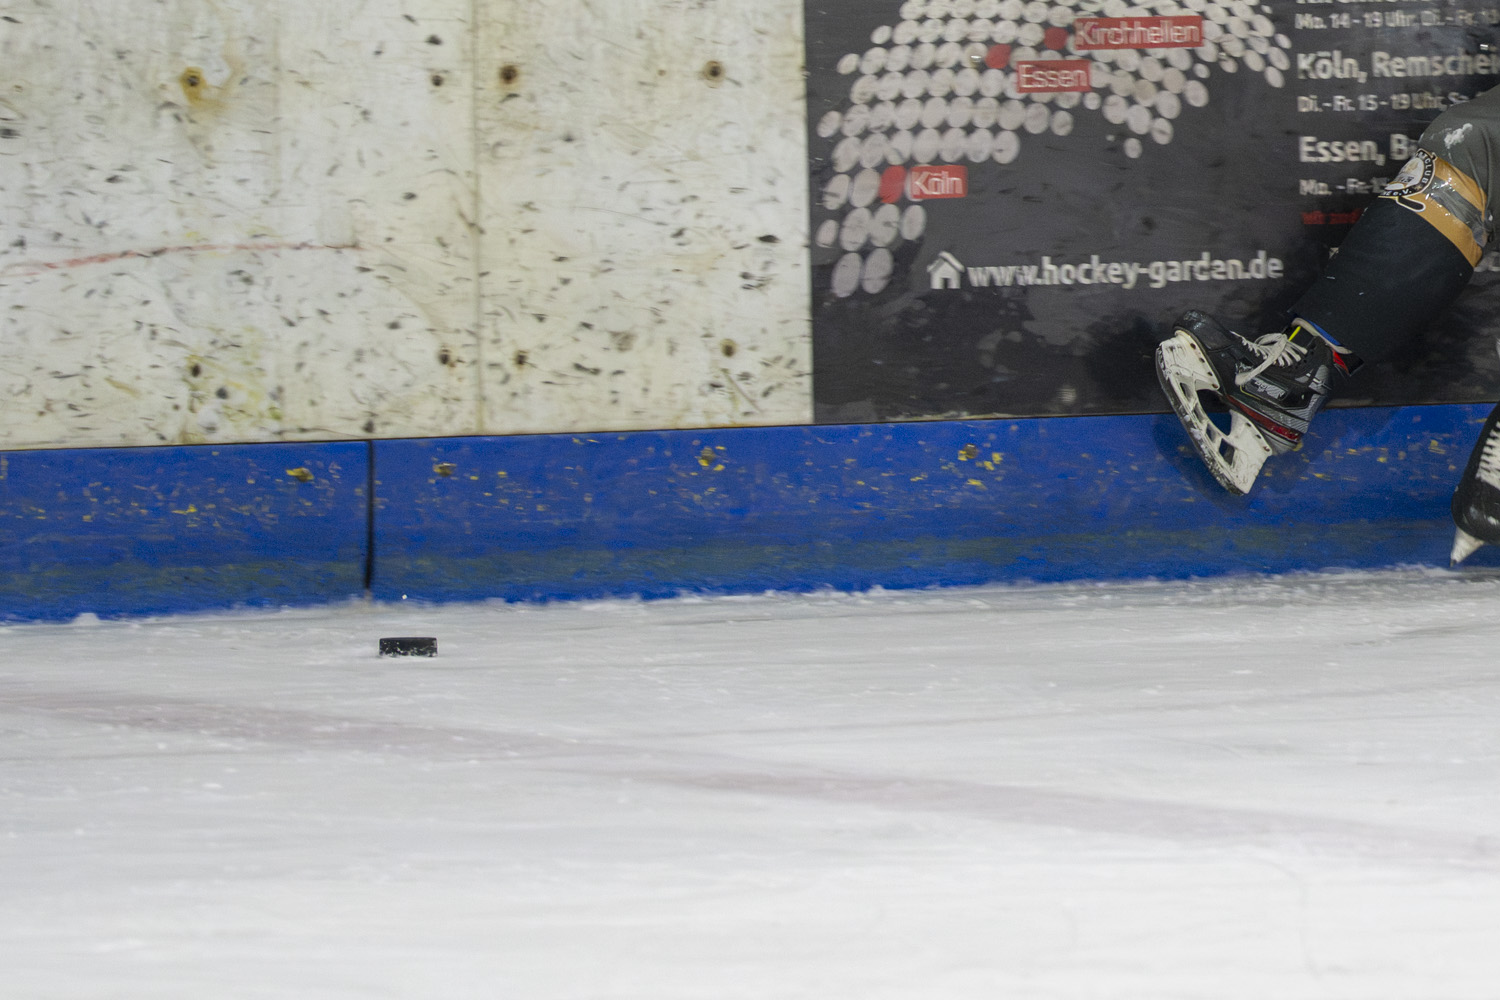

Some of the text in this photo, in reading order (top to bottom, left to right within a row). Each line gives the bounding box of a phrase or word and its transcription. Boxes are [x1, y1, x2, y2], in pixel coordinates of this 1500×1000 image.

[1076, 18, 1200, 46] Kirchhellen
[1020, 63, 1088, 89] Essen
[1297, 49, 1368, 83] Köln,
[1299, 135, 1386, 166] Essen,
[912, 171, 964, 196] Köln
[967, 250, 1284, 290] www.hockey-garden.de
